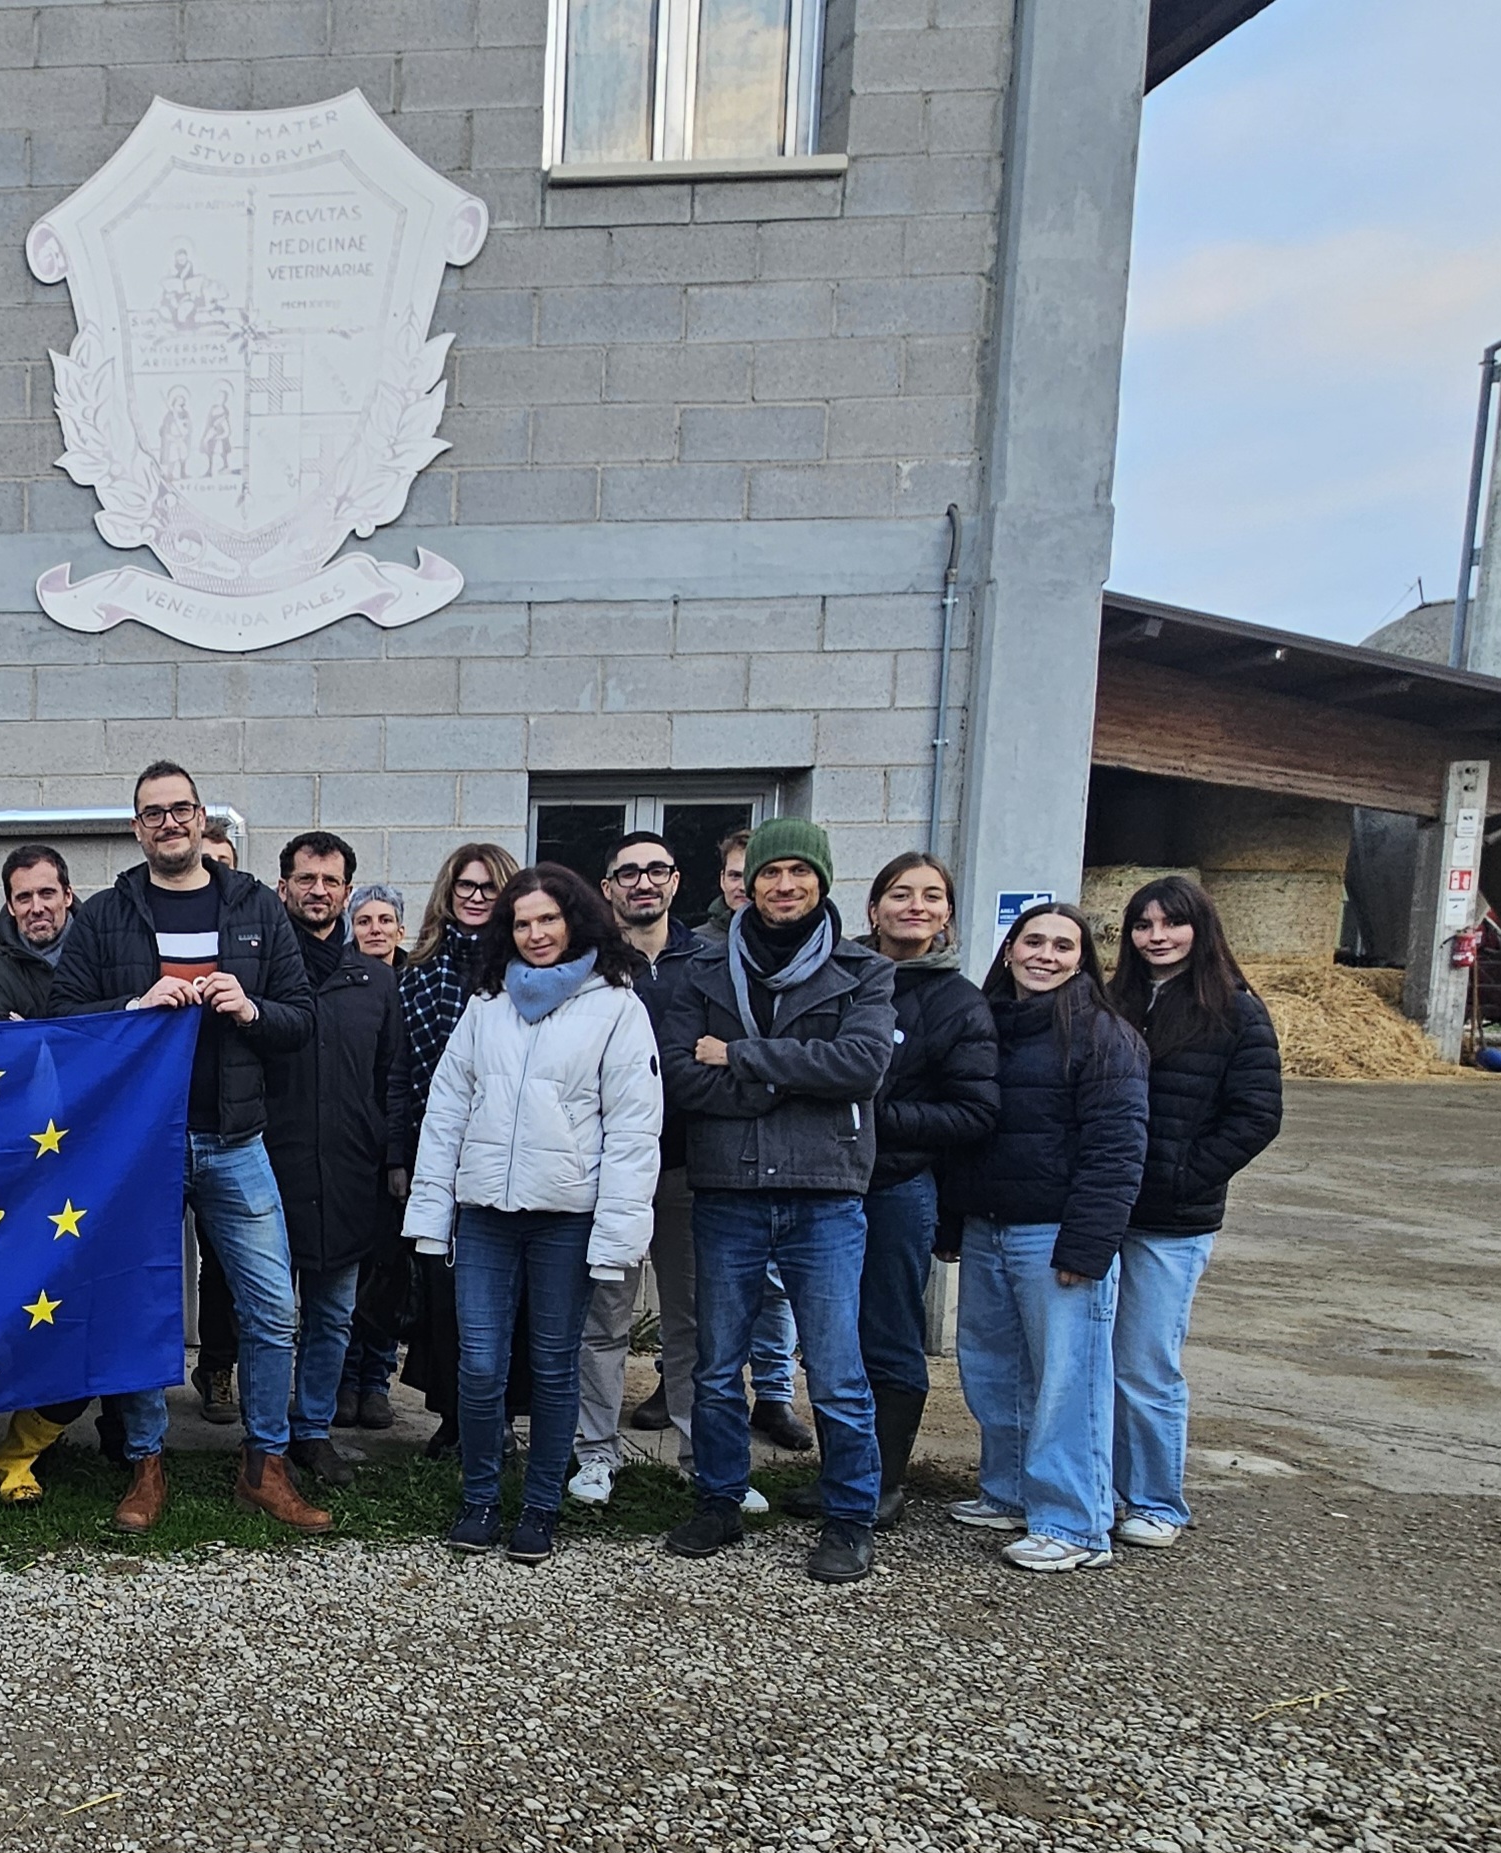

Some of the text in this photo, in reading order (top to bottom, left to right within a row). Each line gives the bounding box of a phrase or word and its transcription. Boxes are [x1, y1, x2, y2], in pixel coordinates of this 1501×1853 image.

[171, 109, 339, 141] ALMA MATER
[190, 139, 323, 165] STVDIORVM
[269, 235, 368, 255] MEDICINAE
[267, 262, 374, 281] VETERINARIAE
[145, 583, 346, 627] VENERANDA PALES
